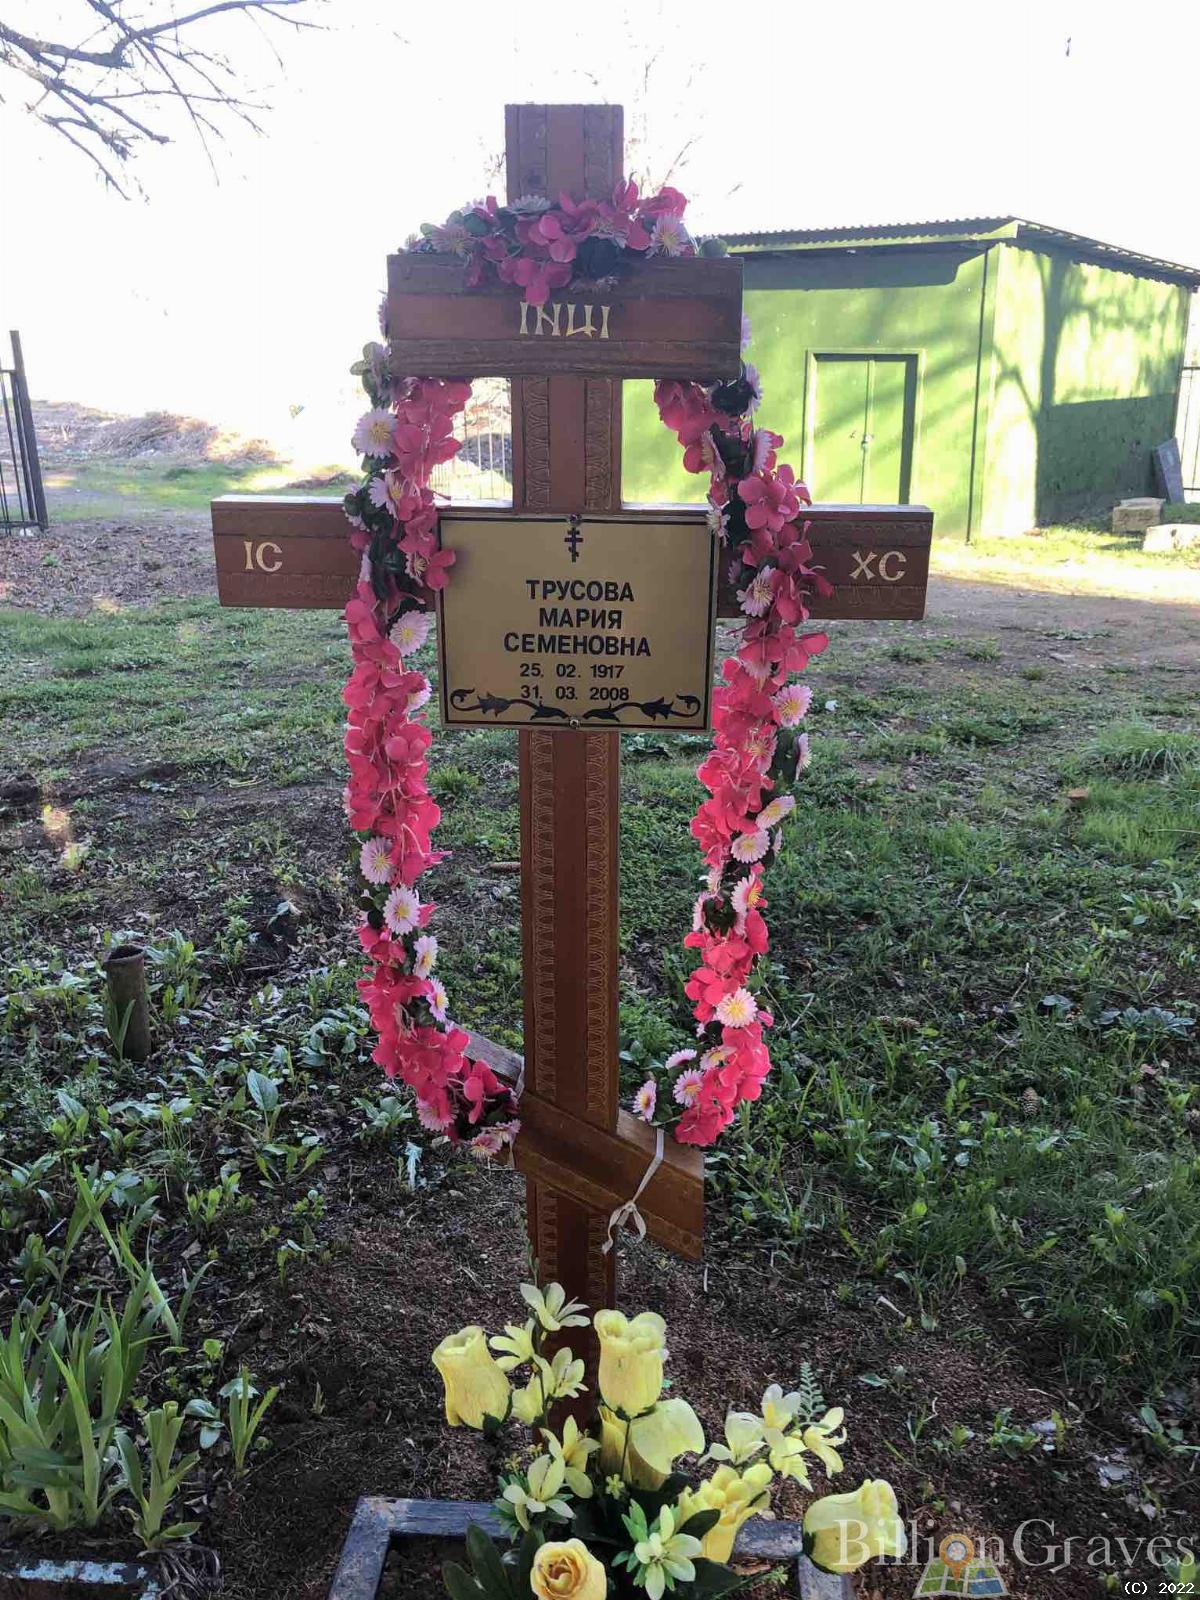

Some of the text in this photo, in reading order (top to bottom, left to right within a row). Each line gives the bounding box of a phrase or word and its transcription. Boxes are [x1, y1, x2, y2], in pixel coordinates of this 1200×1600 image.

[526, 579, 635, 602] ТРУСОВА
[539, 607, 623, 629] МАРИЯ
[503, 632, 651, 656] СЕМЕНОВНА
[519, 663, 625, 679] 25. 02. 1917
[520, 684, 630, 701] 31. 03. 2008
